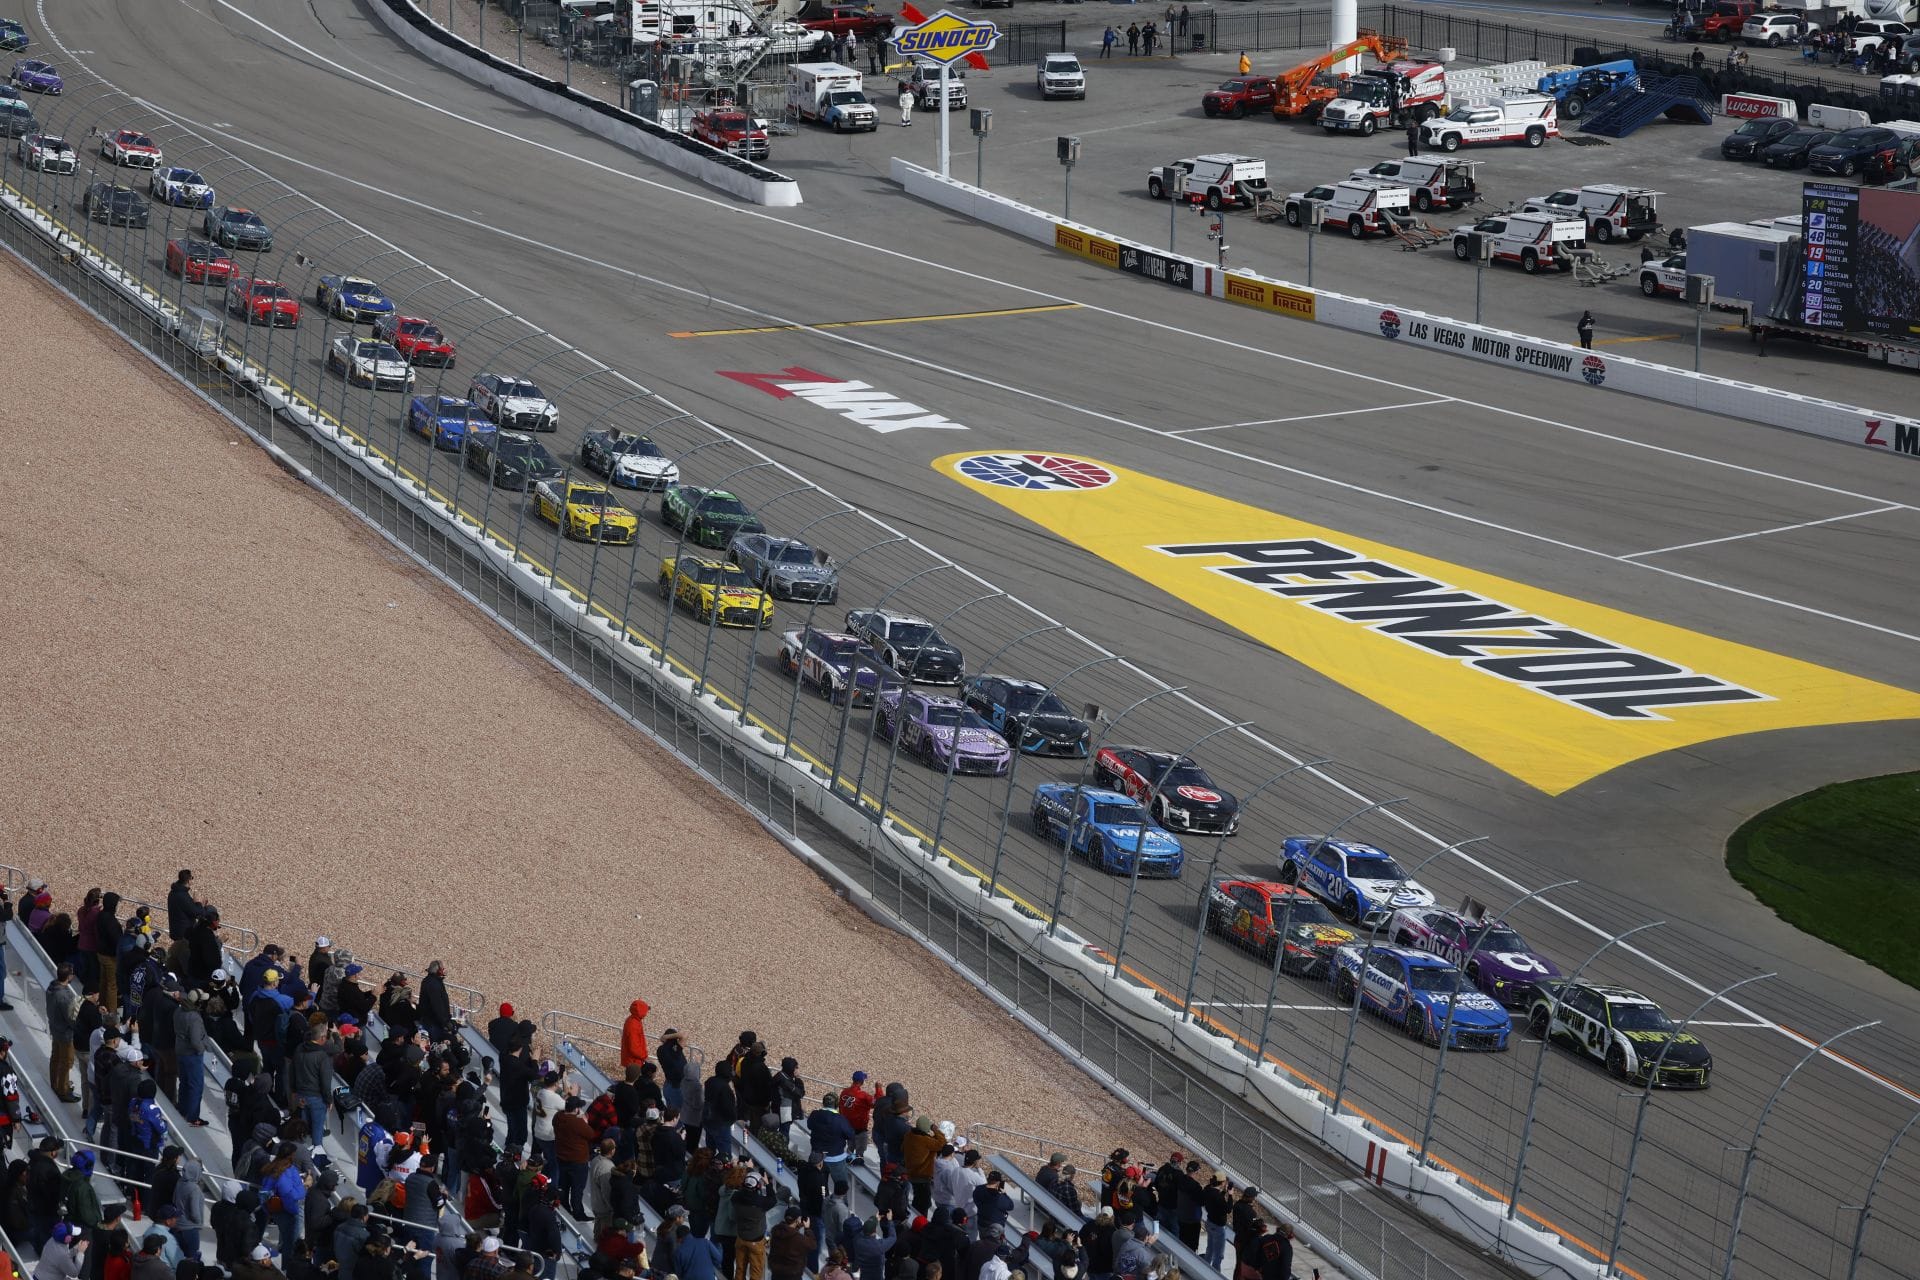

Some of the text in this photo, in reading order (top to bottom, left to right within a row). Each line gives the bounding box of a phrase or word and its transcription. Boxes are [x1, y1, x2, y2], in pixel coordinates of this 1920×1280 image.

[902, 28, 992, 50] SUNOCO
[1727, 100, 1777, 117] LUCAS OIL
[1811, 200, 1825, 209] 24
[1811, 215, 1824, 226] 5
[1057, 229, 1083, 252] PIRELLI
[1810, 231, 1824, 242] 48
[1090, 240, 1118, 262] PIRELLI
[1809, 247, 1823, 259] 19
[1812, 263, 1819, 275] 1
[1227, 279, 1265, 303] PIRELLI
[1808, 280, 1822, 290] 20
[1272, 290, 1313, 314] PIRELLI
[1807, 311, 1821, 323] 4
[1408, 321, 1573, 373] LAS VEGAS MOTOR SPEEDWAY
[713, 366, 971, 434] ZMAX
[1145, 537, 1780, 721] PENNZOIL
[1327, 872, 1343, 900] 20
[1415, 933, 1446, 957] ally
[133, 971, 144, 984] 48
[1588, 1020, 1606, 1054] 24
